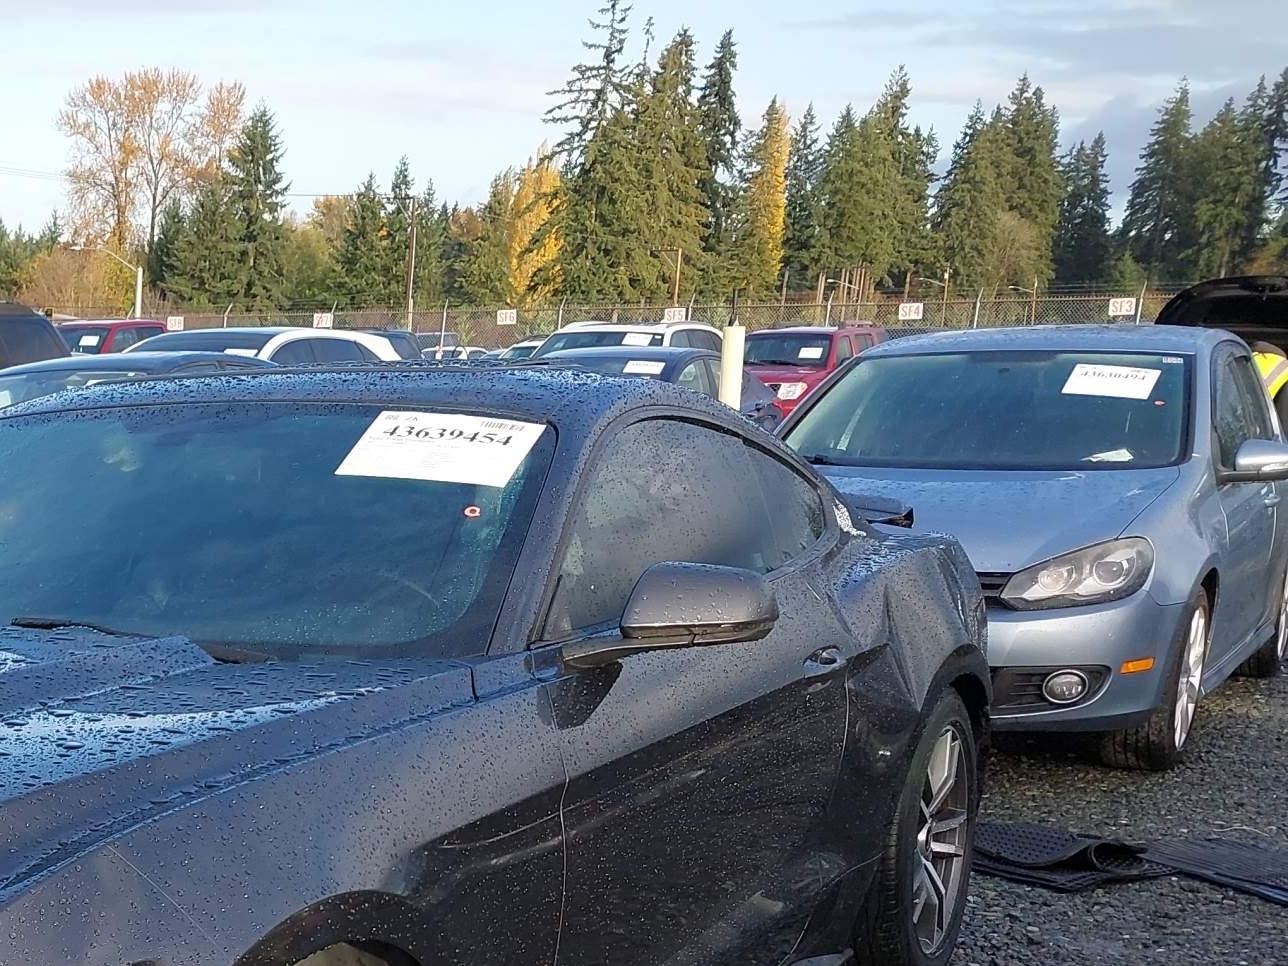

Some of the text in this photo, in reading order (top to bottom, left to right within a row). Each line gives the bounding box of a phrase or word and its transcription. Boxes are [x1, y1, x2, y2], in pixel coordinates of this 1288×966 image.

[901, 304, 921, 318] SF4
[1111, 299, 1134, 313] SF3
[666, 309, 684, 321] SF5
[382, 424, 513, 446] 43639454
